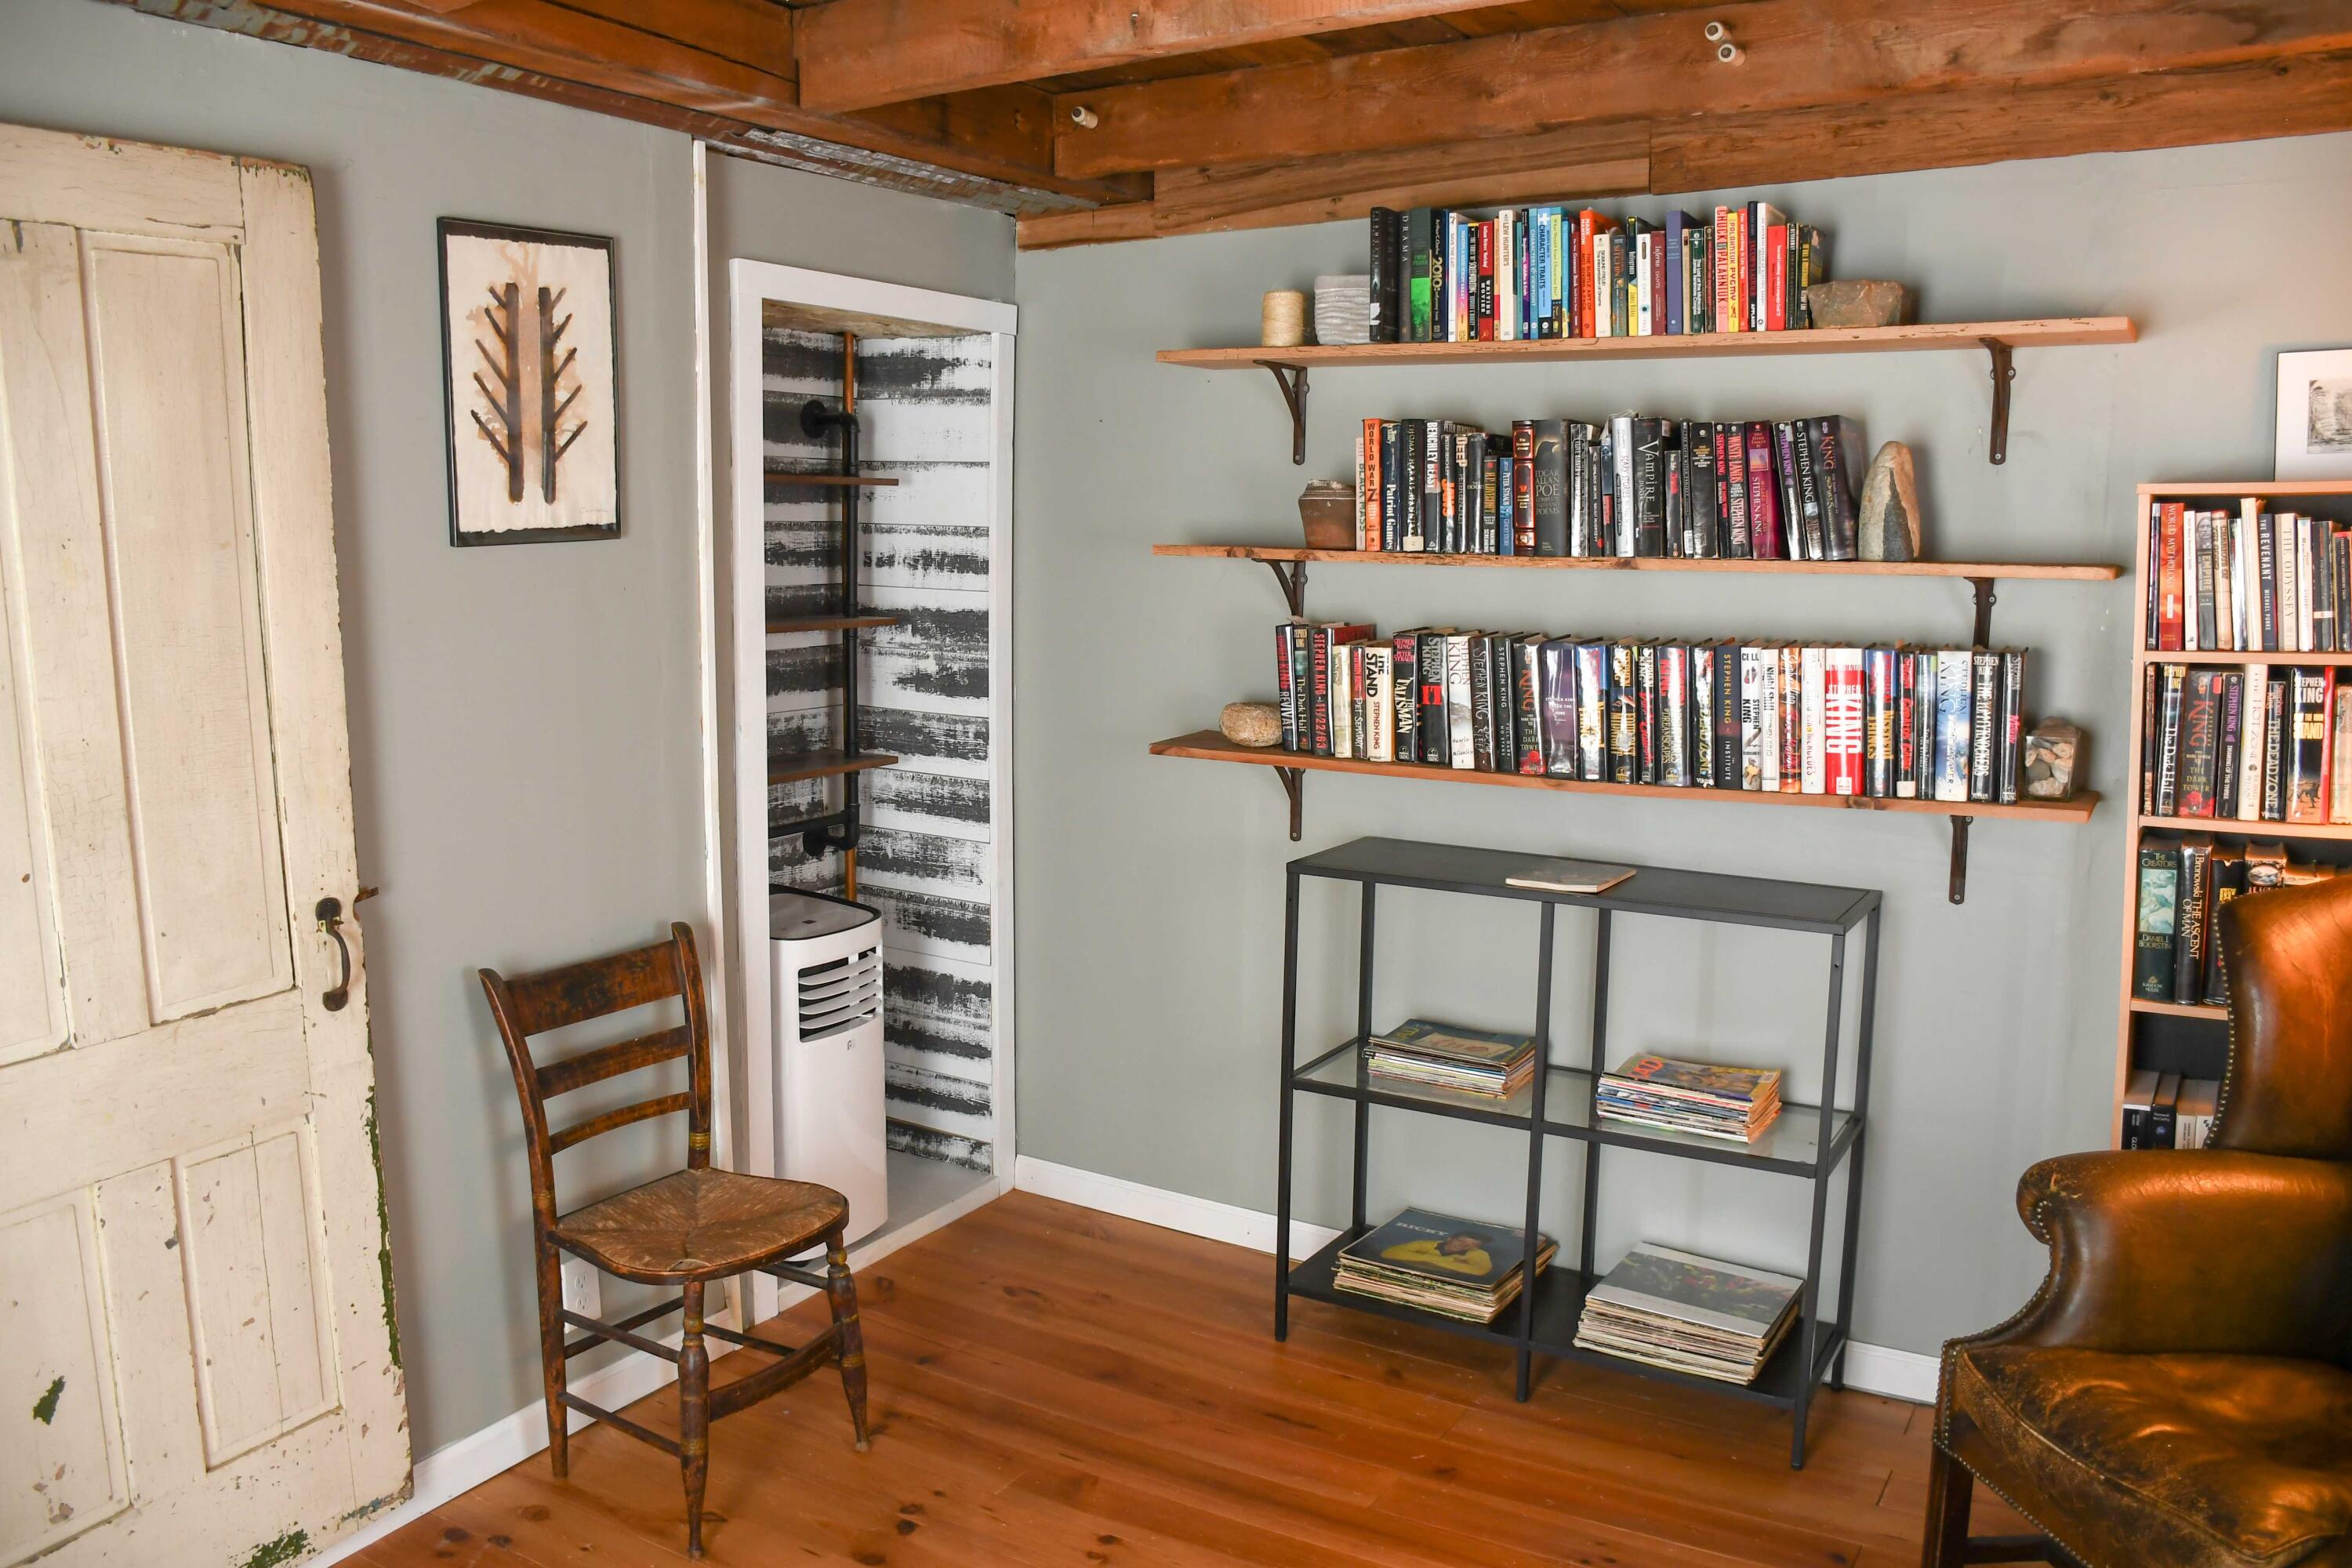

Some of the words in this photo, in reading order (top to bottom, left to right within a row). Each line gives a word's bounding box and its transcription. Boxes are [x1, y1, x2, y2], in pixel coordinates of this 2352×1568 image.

[1717, 210, 1726, 239] CHUCK
[1432, 257, 1443, 291] 2010:
[1717, 252, 1726, 303] PALAHNIUK
[1427, 422, 1438, 463] BENCHLEY
[1456, 437, 1468, 466] DEEP
[1729, 435, 1742, 459] WASTE
[1779, 432, 1791, 459] STEPHEN
[1797, 432, 1809, 474] STEPHEN
[1820, 436, 1835, 470] KING
[1427, 464, 1438, 488] BEAST
[1637, 439, 1659, 502] VAMPIRE
[1730, 461, 1743, 483] LANDS
[1784, 460, 1793, 475] KING
[1367, 488, 1377, 502] Z
[1386, 485, 1396, 516] Patriot
[1442, 479, 1454, 517] JAWS
[1536, 485, 1559, 496] POE
[1621, 476, 1631, 499] STORIES
[1752, 477, 1762, 511] STEPHEN
[1802, 477, 1813, 503] KING
[1730, 498, 1744, 527] STEPHEN
[2168, 505, 2176, 535] WORLD
[1386, 519, 1396, 550] Games
[1731, 529, 1745, 544] KING
[2282, 528, 2292, 555] THE
[2167, 538, 2176, 589] MYTHOLOGY
[2260, 533, 2271, 580] REVENANT
[2202, 555, 2212, 591] EMPIRE
[2284, 561, 2293, 619] ODYSSEY
[1314, 634, 1326, 671] STEPHEN
[1428, 637, 1442, 683] STEPHEN
[1448, 642, 1461, 684] KING
[1461, 641, 1470, 685] STEPHEN
[1973, 656, 1998, 666] STEPHEN
[1367, 653, 1377, 697] STAND
[1472, 648, 1486, 688] STEPHEN
[1297, 677, 1305, 692] The
[1316, 674, 1326, 695] KING
[1956, 660, 1968, 714] STEPHEN
[1977, 682, 1992, 699] THE
[2228, 685, 2238, 713] STEPHEN
[2294, 688, 2324, 703] KING
[1279, 691, 1293, 732] REVIVAL
[1298, 693, 1306, 713] Dark
[1395, 677, 1414, 734] TALISMAN
[1474, 691, 1489, 720] KING
[1742, 699, 1751, 723] KING
[2251, 699, 2261, 727] HOT
[2275, 685, 2284, 715] Stephen
[1298, 714, 1307, 732] Half
[1316, 702, 1327, 749] 11/22/63
[1355, 717, 1364, 749] SEMATARY
[1826, 694, 1860, 753] KING
[2165, 725, 2177, 745] The
[2188, 700, 2214, 747] KING
[2227, 716, 2236, 731] KING
[2268, 718, 2281, 741] THE
[2293, 722, 2324, 739] STAND
[1474, 725, 1484, 753] SLEEP
[1867, 717, 1877, 759] THINGS
[1974, 702, 1991, 776] TOMMYKNOCKERS
[2249, 730, 2258, 762] ZONE
[2164, 746, 2176, 769] Dark
[2267, 744, 2280, 774] DEAD
[2162, 771, 2175, 793] Half
[2266, 775, 2278, 808] ZONE
[2142, 858, 2177, 867] CREATORS
[2154, 852, 2166, 861] THE
[2193, 858, 2205, 898] Bronowski
[2183, 899, 2192, 913] OF
[2192, 900, 2202, 919] THE
[2181, 913, 2190, 938] MAN
[2189, 920, 2201, 960] ASCENT
[1396, 1222, 1449, 1236] RICKY
